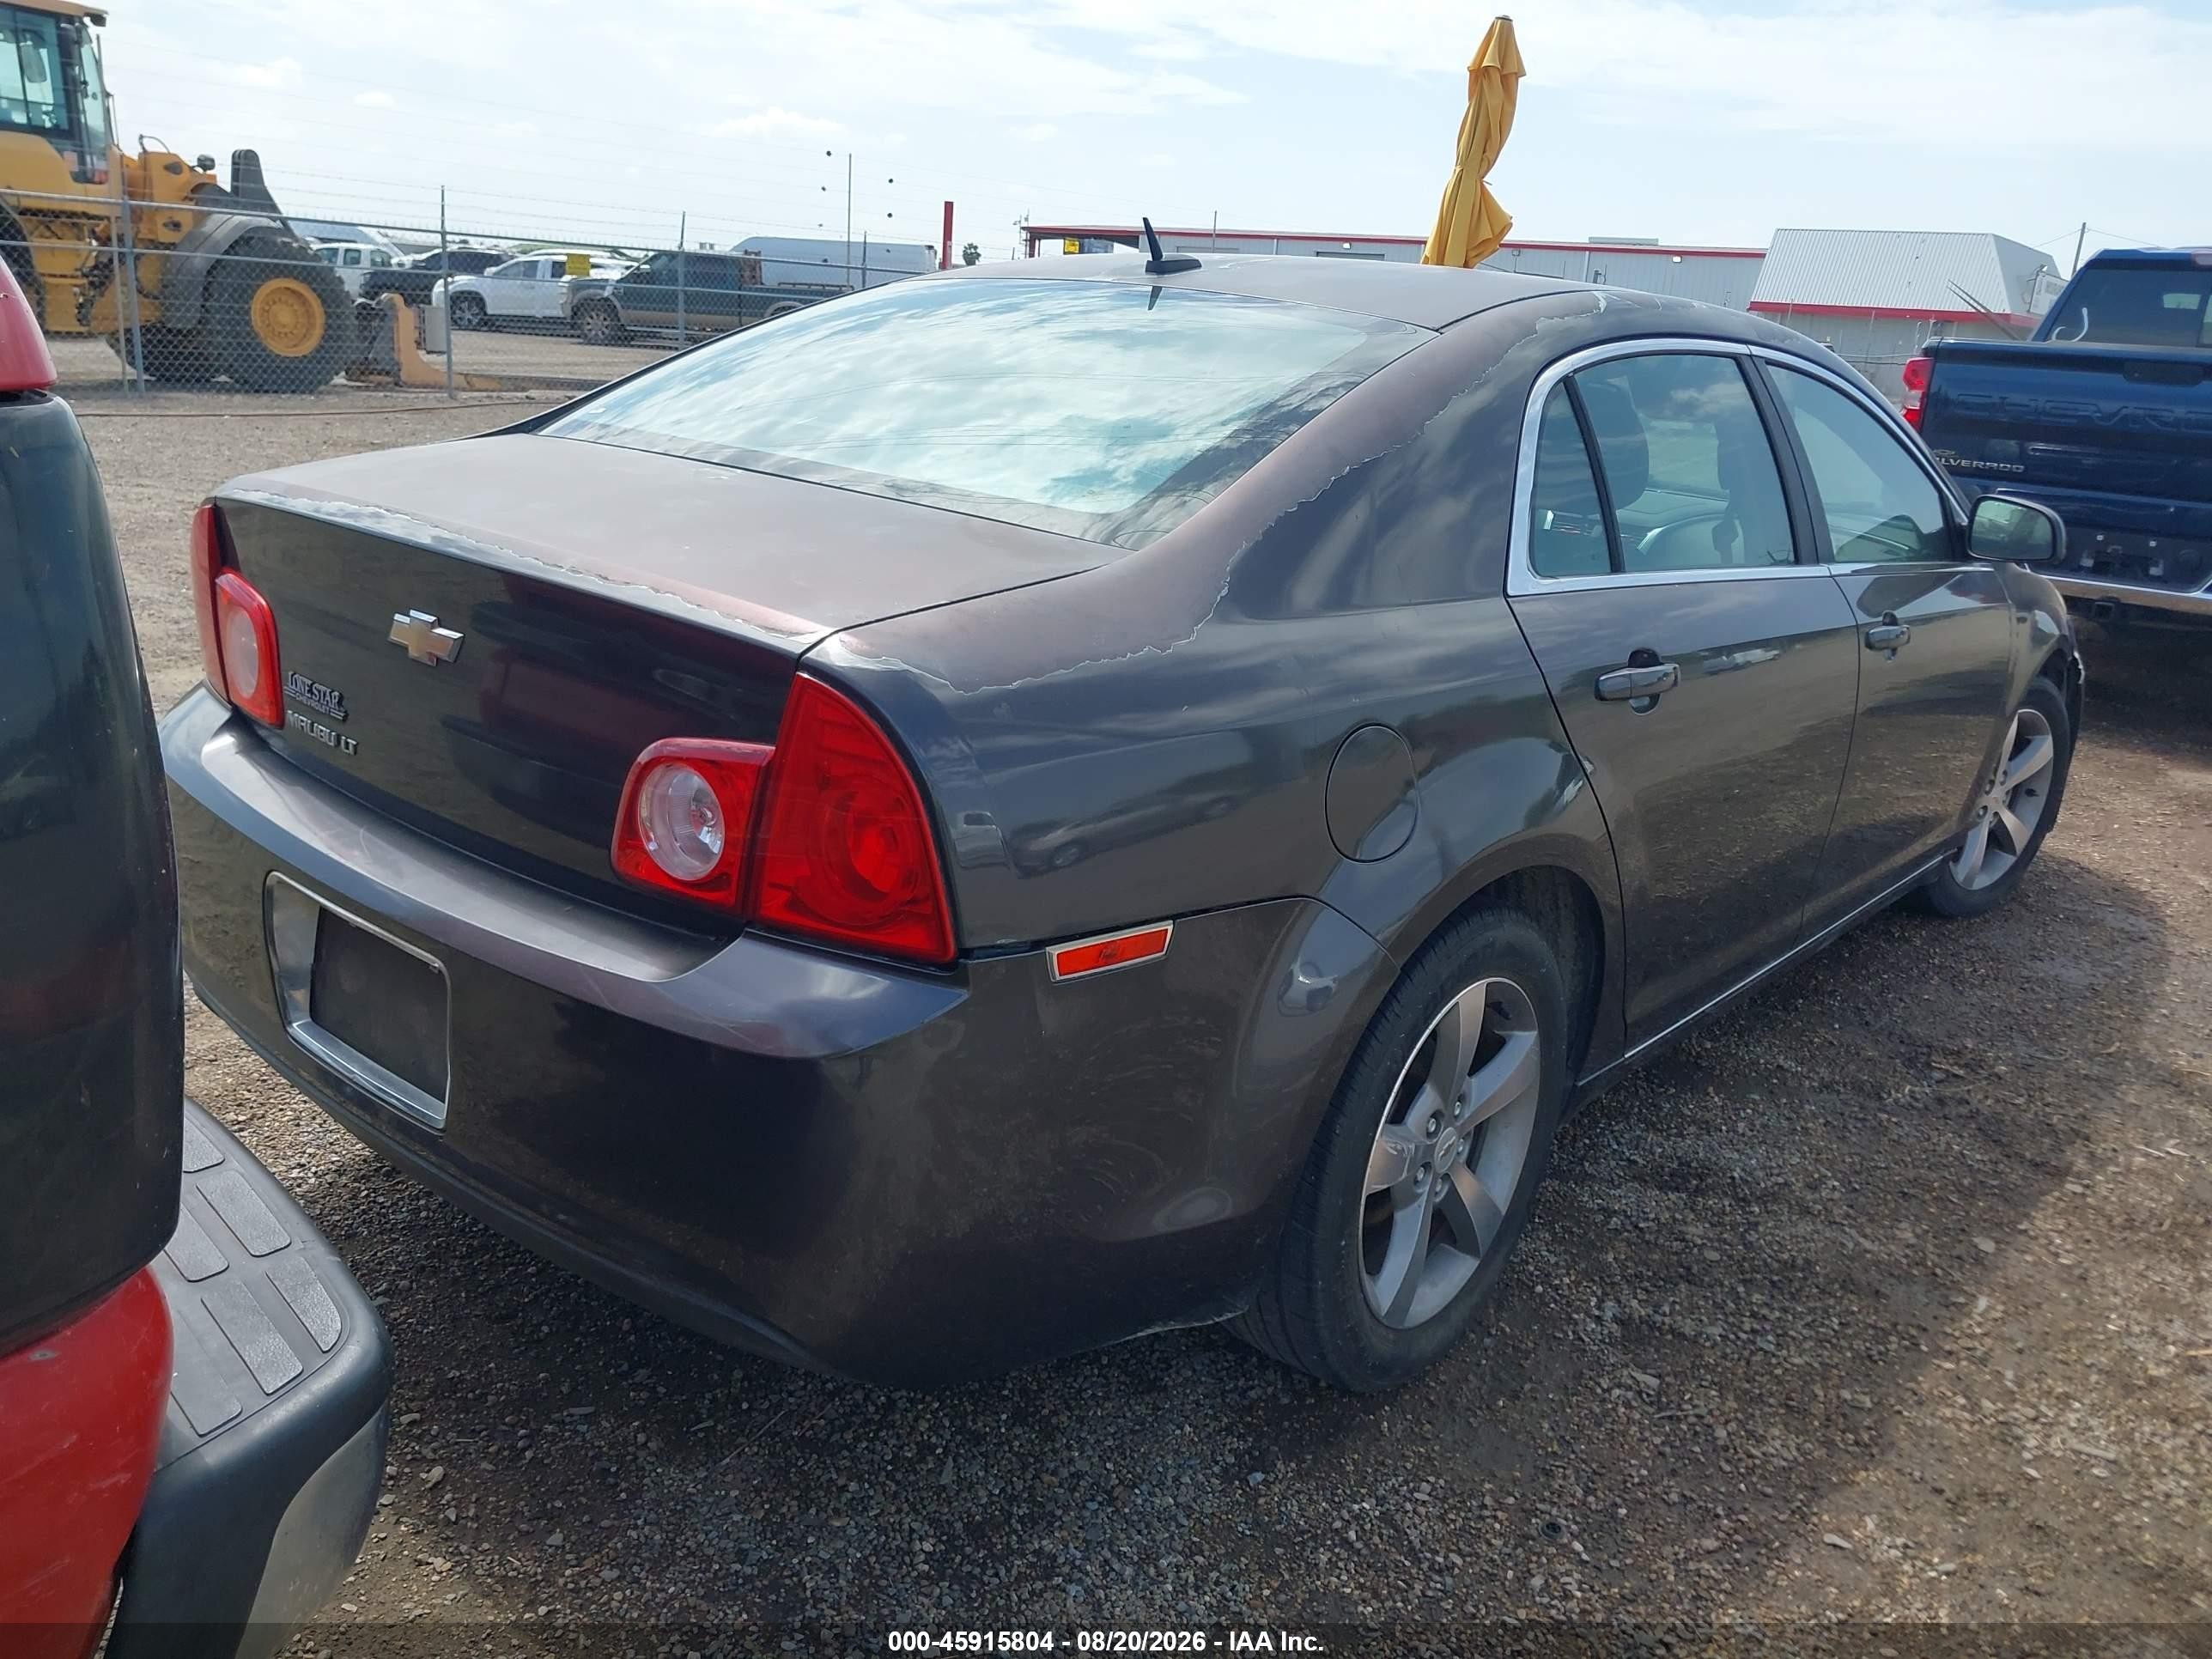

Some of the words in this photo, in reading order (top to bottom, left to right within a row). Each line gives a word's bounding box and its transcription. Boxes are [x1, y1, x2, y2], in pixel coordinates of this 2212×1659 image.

[288, 672, 313, 698] LONE
[312, 683, 340, 710] STAR
[287, 709, 337, 747] MALIBU
[340, 735, 358, 756] LT
